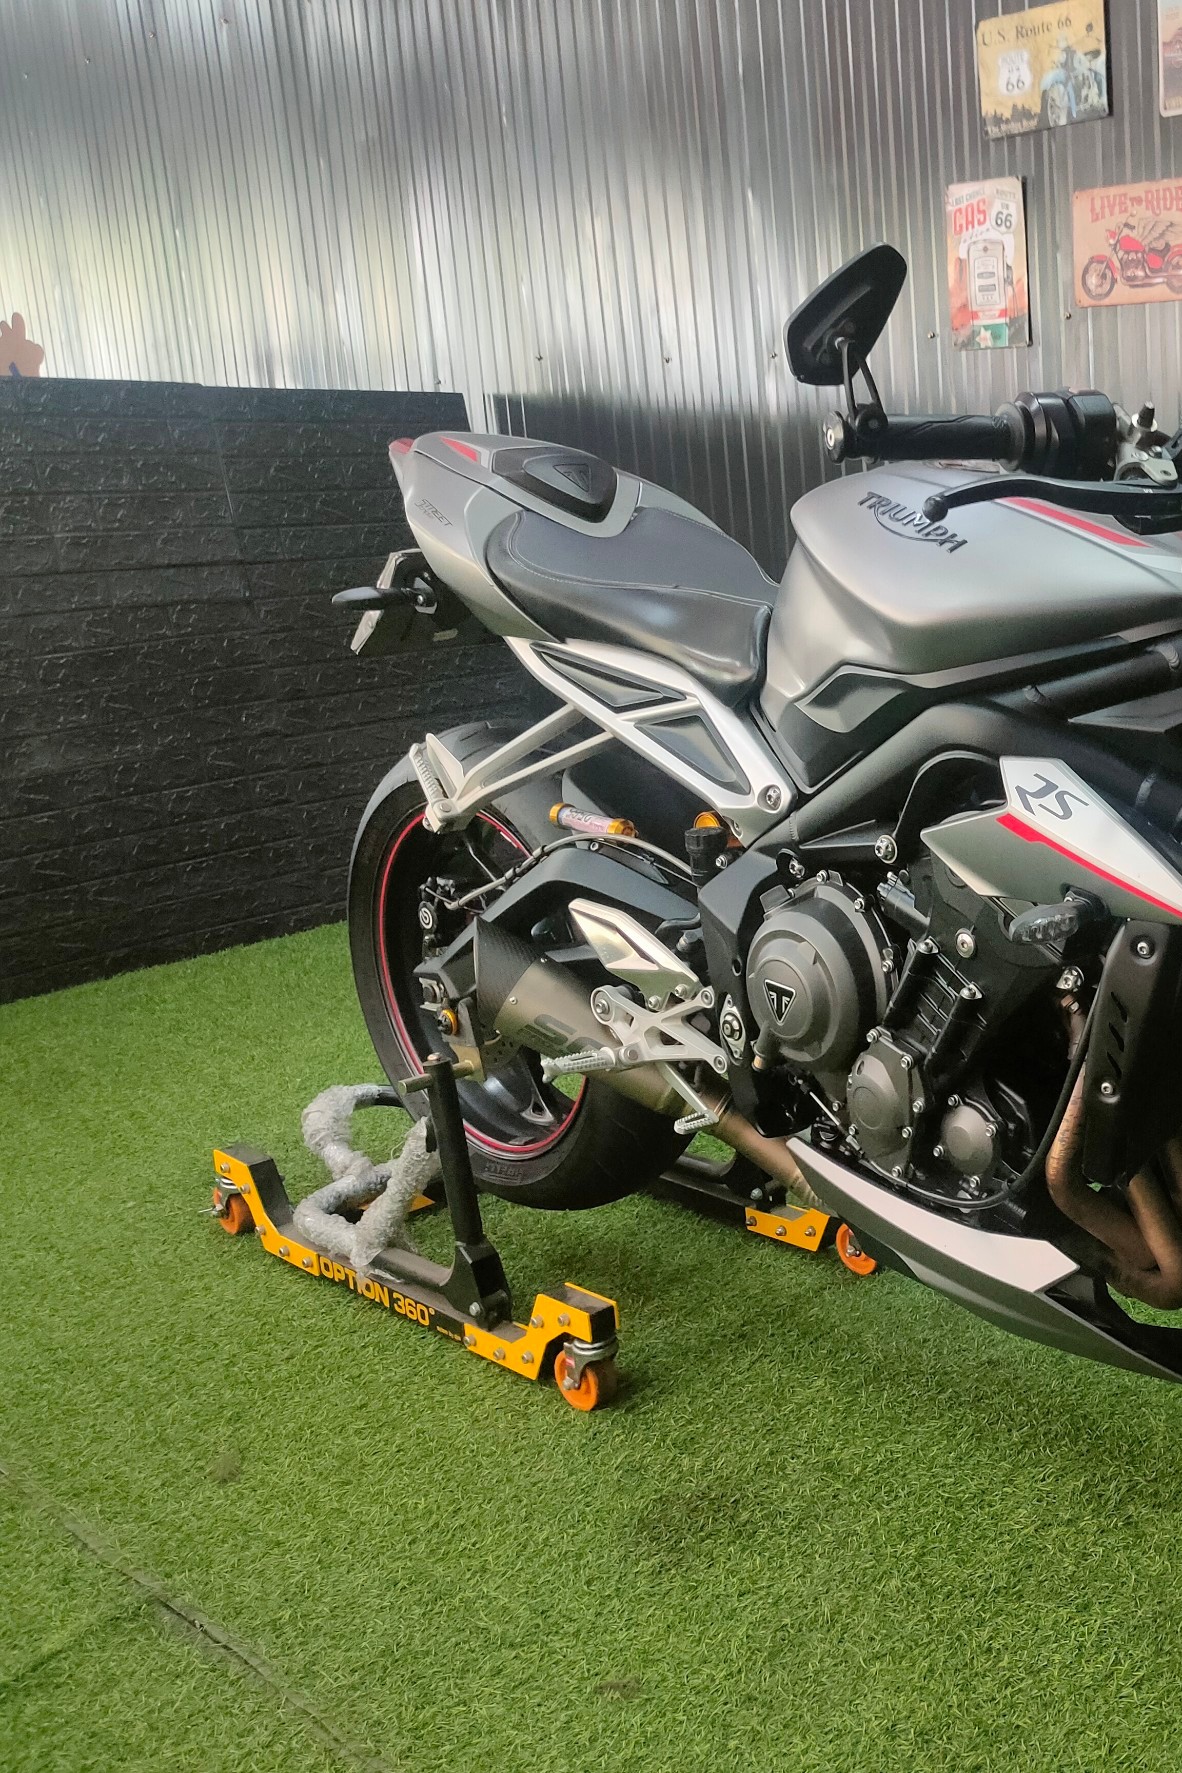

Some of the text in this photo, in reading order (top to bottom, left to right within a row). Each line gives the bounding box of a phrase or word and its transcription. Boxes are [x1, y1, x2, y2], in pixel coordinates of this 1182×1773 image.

[1014, 21, 1053, 40] Route
[1056, 17, 1072, 30] 66
[1005, 74, 1026, 93] 66
[953, 197, 988, 237] GAS
[994, 210, 1013, 230] 66
[1090, 193, 1129, 223] LIVE
[857, 491, 969, 554] TRIUMPH
[319, 1256, 390, 1308] OPTION
